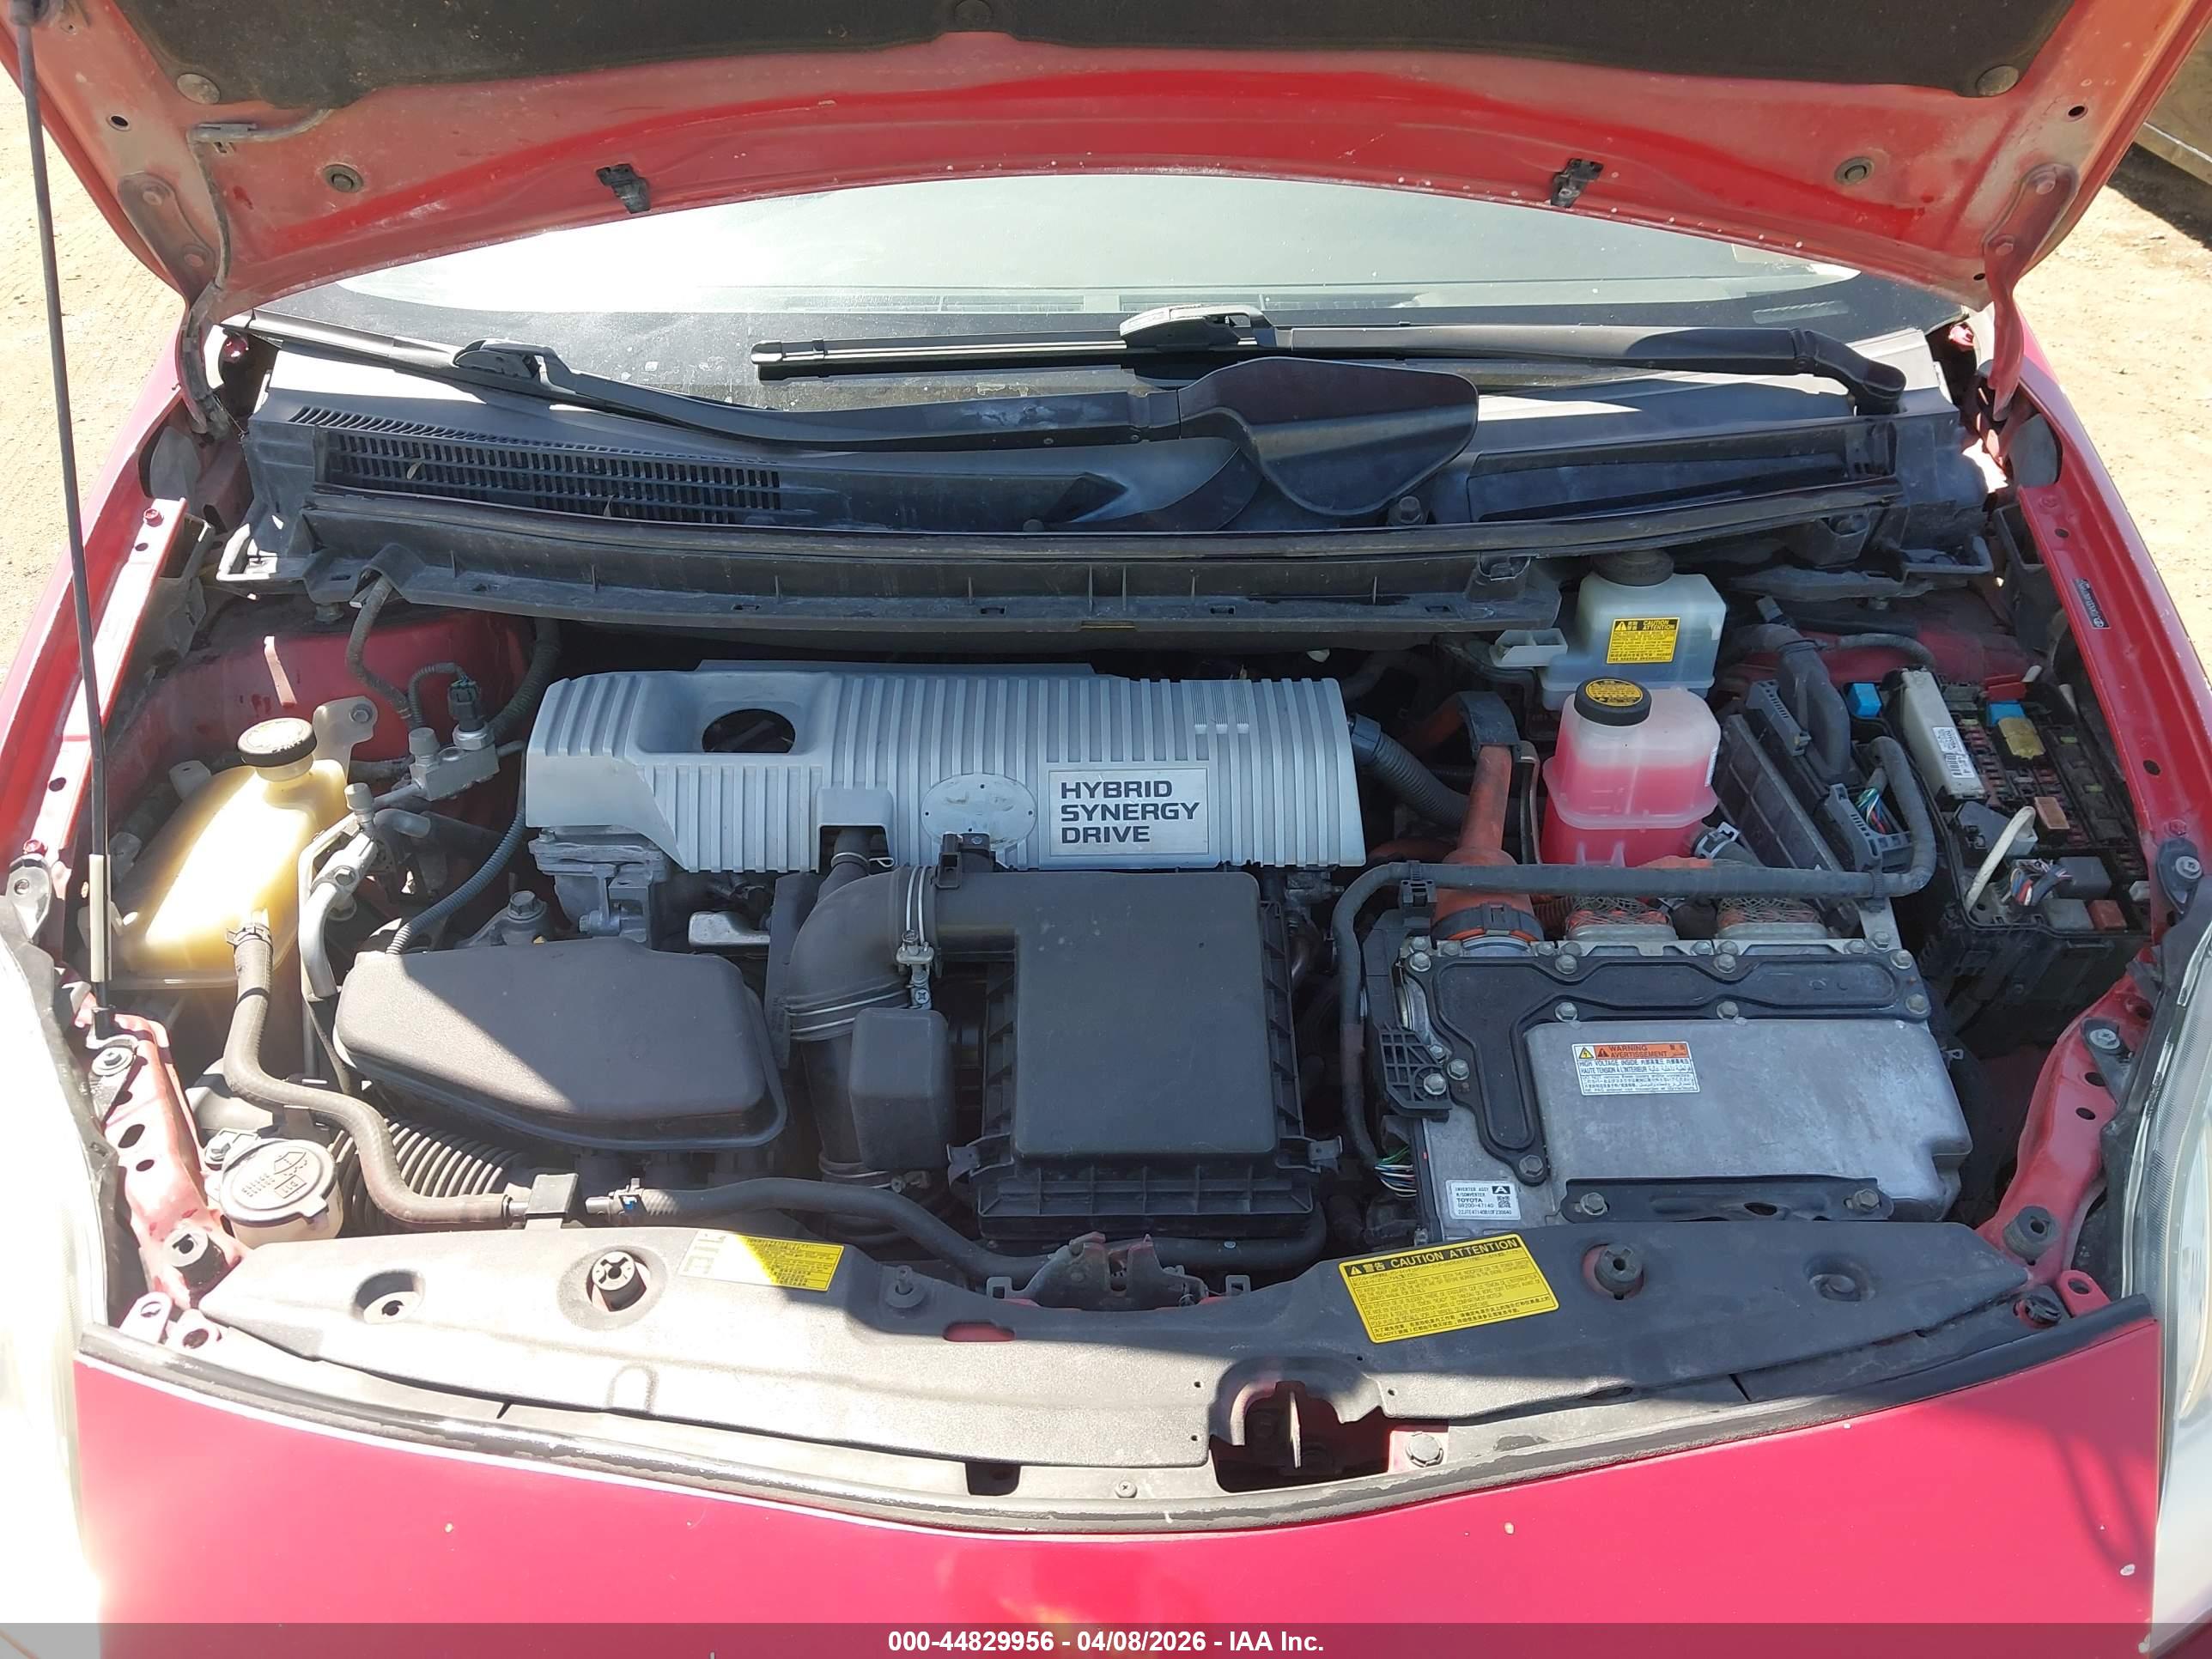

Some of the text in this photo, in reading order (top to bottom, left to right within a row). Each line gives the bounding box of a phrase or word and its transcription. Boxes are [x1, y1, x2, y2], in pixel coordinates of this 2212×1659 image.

[1060, 780, 1173, 799] HYBRID
[1060, 802, 1200, 822] SYNERGY
[1061, 825, 1151, 844] DRIVE
[1390, 1238, 1518, 1268] CAUTION ATTENTION
